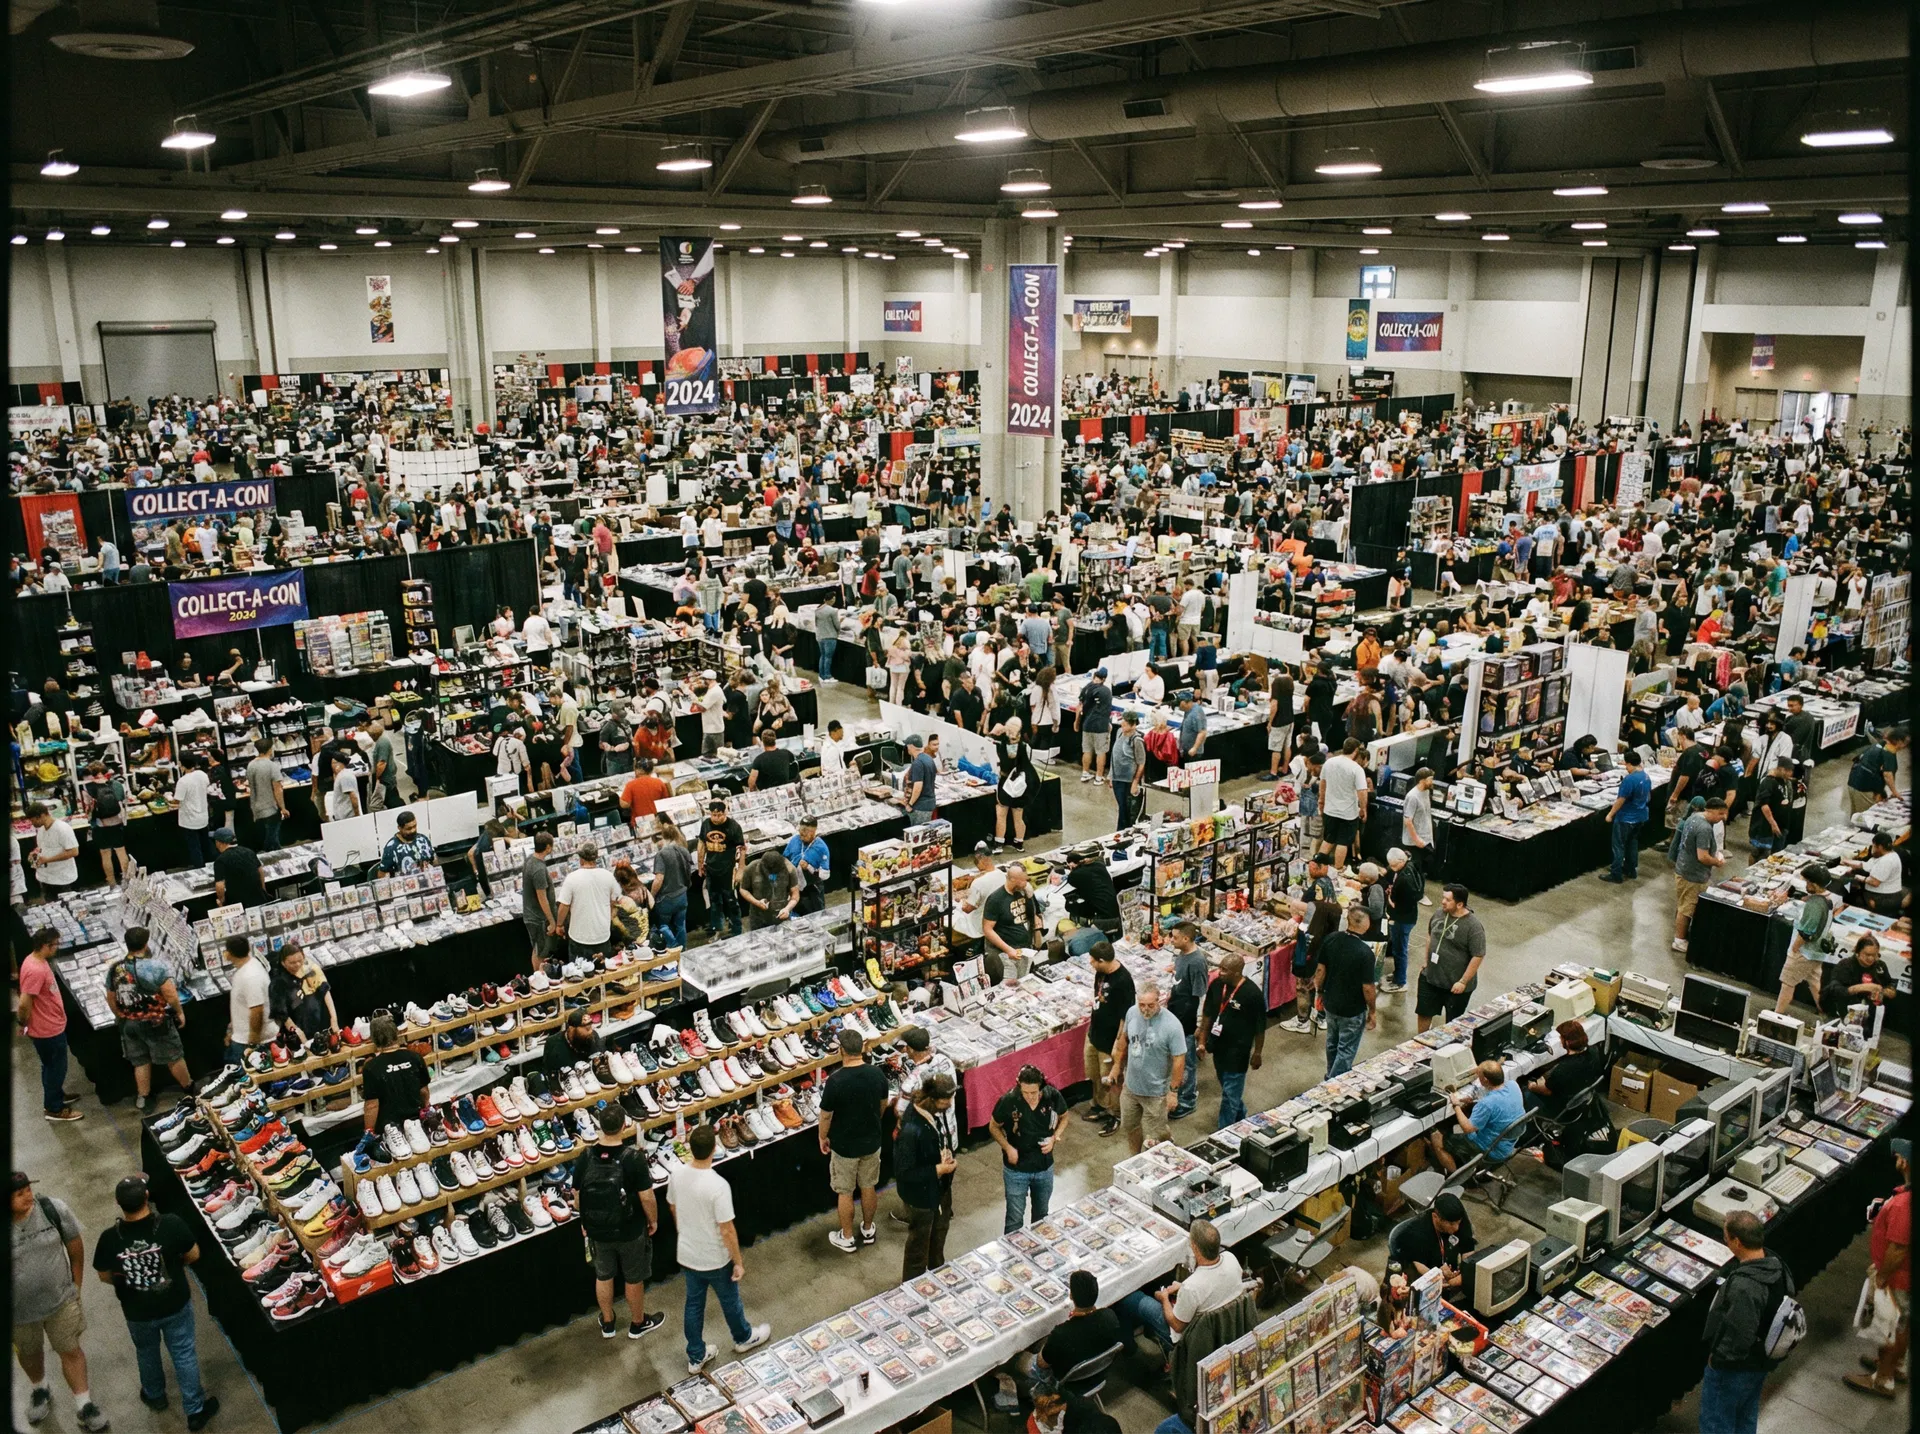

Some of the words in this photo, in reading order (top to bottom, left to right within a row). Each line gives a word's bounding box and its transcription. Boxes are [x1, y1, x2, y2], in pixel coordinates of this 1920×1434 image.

[1023, 273, 1041, 397] COLLECT-A-CON
[1379, 323, 1440, 337] COLLECT-A-CON
[667, 380, 716, 406] 2024
[1010, 402, 1051, 429] 2024
[132, 484, 269, 516] COLLECT-A-CON
[178, 581, 301, 618] COLLECT-A-CON
[229, 609, 257, 622] 2024
